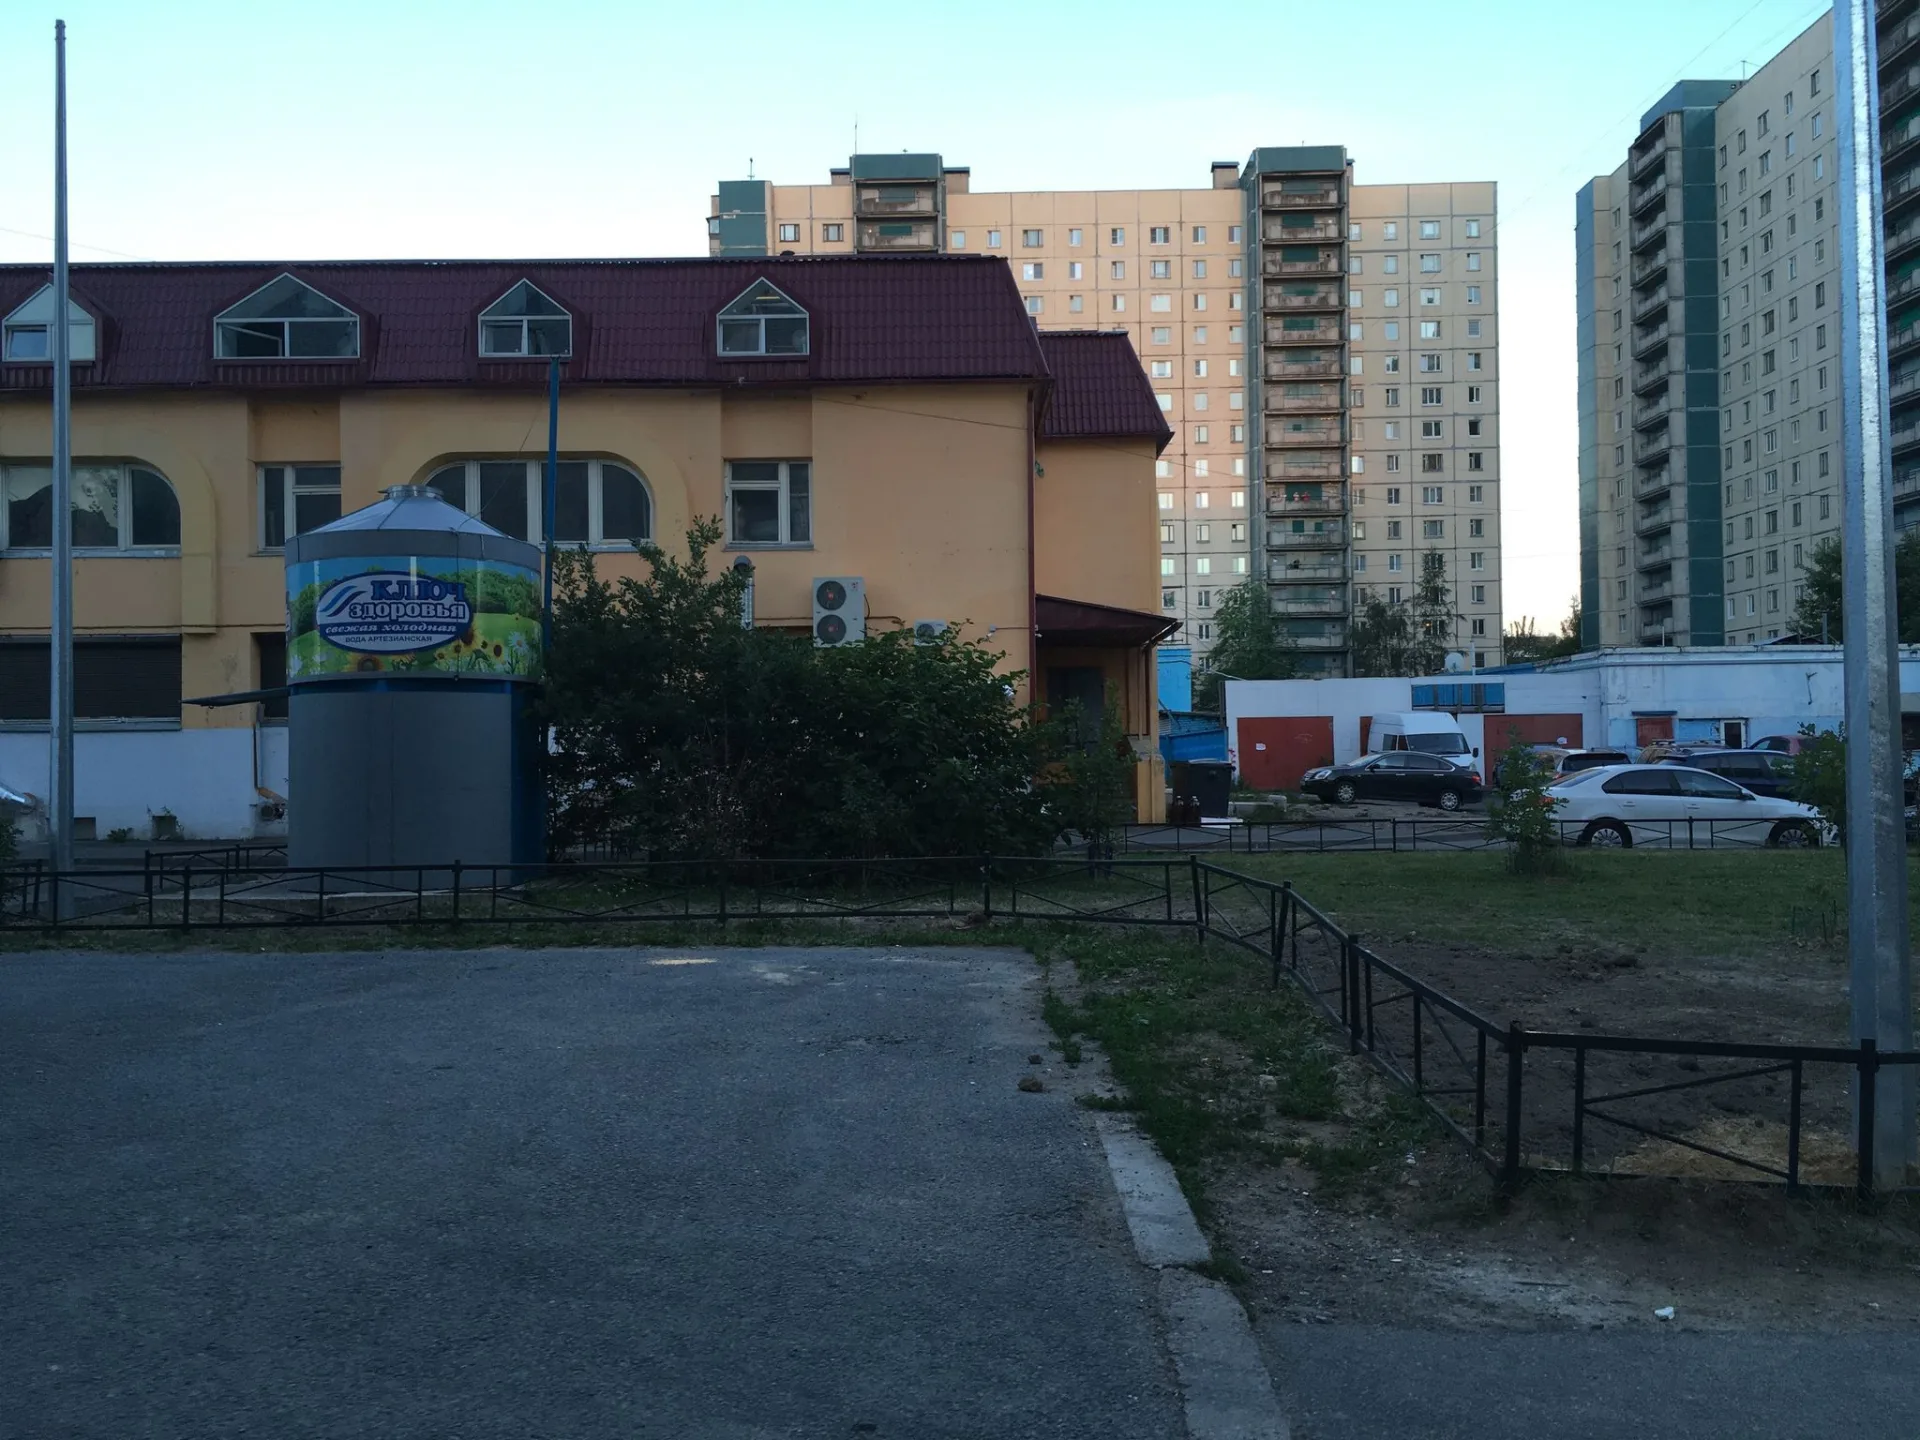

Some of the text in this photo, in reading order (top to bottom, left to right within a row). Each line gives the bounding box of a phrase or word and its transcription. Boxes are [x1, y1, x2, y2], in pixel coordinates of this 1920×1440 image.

[371, 580, 466, 602] КЛЮЧ
[349, 601, 466, 620] здоровья
[325, 622, 457, 634] свежая холодная
[368, 635, 433, 643] АРТЕЗИАНСКАЯ
